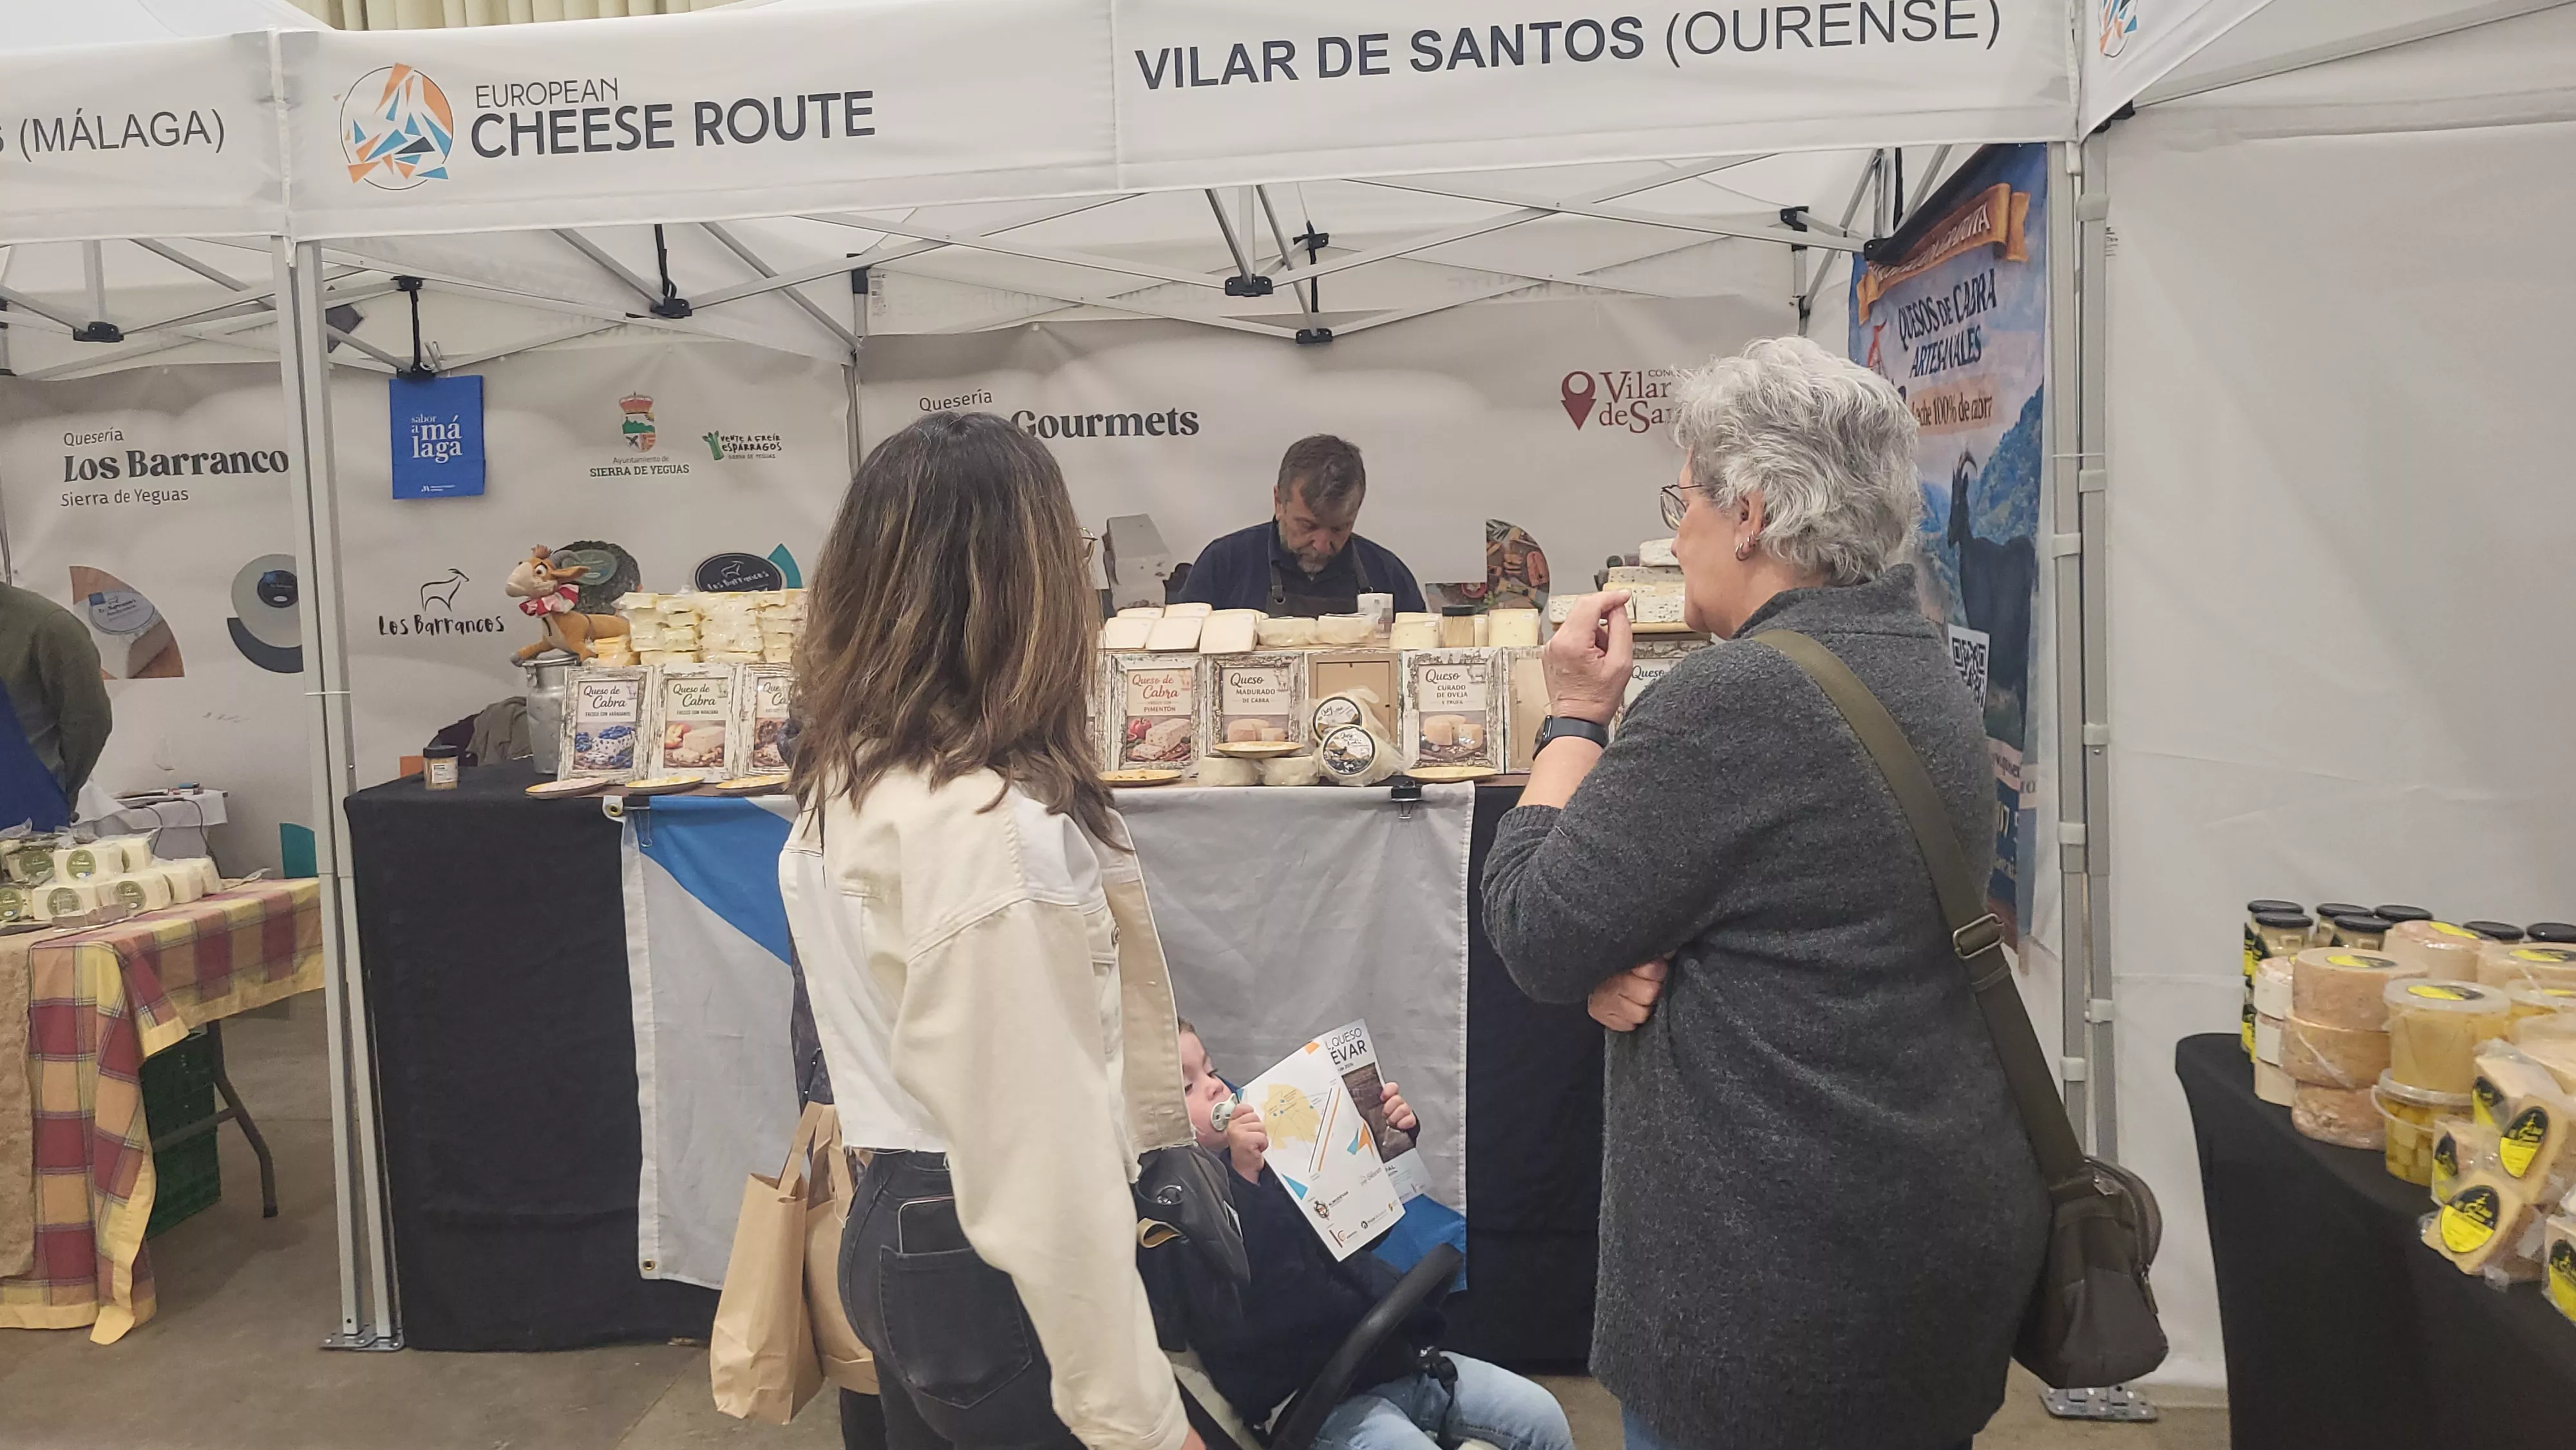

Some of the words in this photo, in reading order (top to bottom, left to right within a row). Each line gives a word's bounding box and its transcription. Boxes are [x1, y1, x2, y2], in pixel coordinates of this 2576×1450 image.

[1135, 40, 1299, 90] VILAR
[1318, 33, 1390, 79] DE
[1410, 15, 1643, 72] SANTOS
[1666, 0, 2000, 68] (OURENSE)
[476, 78, 618, 108] EUROPEAN
[471, 103, 675, 158] CHEESE
[694, 90, 875, 146] ROUTE
[20, 108, 225, 162] (MÁLAGA)
[1599, 371, 1672, 403] Vilar
[919, 388, 992, 411] Quesería
[411, 424, 419, 433] a
[421, 414, 463, 441] má
[412, 413, 437, 423] sabor
[1010, 407, 1200, 438] Gourmets
[64, 427, 124, 446] Quesería
[412, 435, 463, 464] laga
[64, 455, 120, 483] Los
[126, 449, 289, 478] Barranco
[590, 466, 631, 477] SIERRA
[634, 465, 649, 475] DE
[650, 464, 690, 475] YEGUAS
[61, 491, 109, 507] Sierra
[115, 489, 130, 503] de
[135, 488, 189, 505] Yeguas
[379, 616, 408, 636] Los
[414, 614, 504, 636] Barrancos
[1132, 674, 1160, 686] Queso
[1162, 674, 1174, 684] de
[1230, 672, 1265, 688] Queso
[1425, 668, 1461, 684] Queso
[583, 685, 609, 697] Queso
[610, 685, 620, 694] de
[673, 683, 698, 695] Queso
[700, 683, 710, 693] de
[1142, 684, 1179, 699] Cabra
[592, 695, 627, 709] Cabra
[682, 693, 717, 707] Cabra
[1332, 1028, 1362, 1047] QUESO
[1330, 1040, 1367, 1065] ÉVAR
